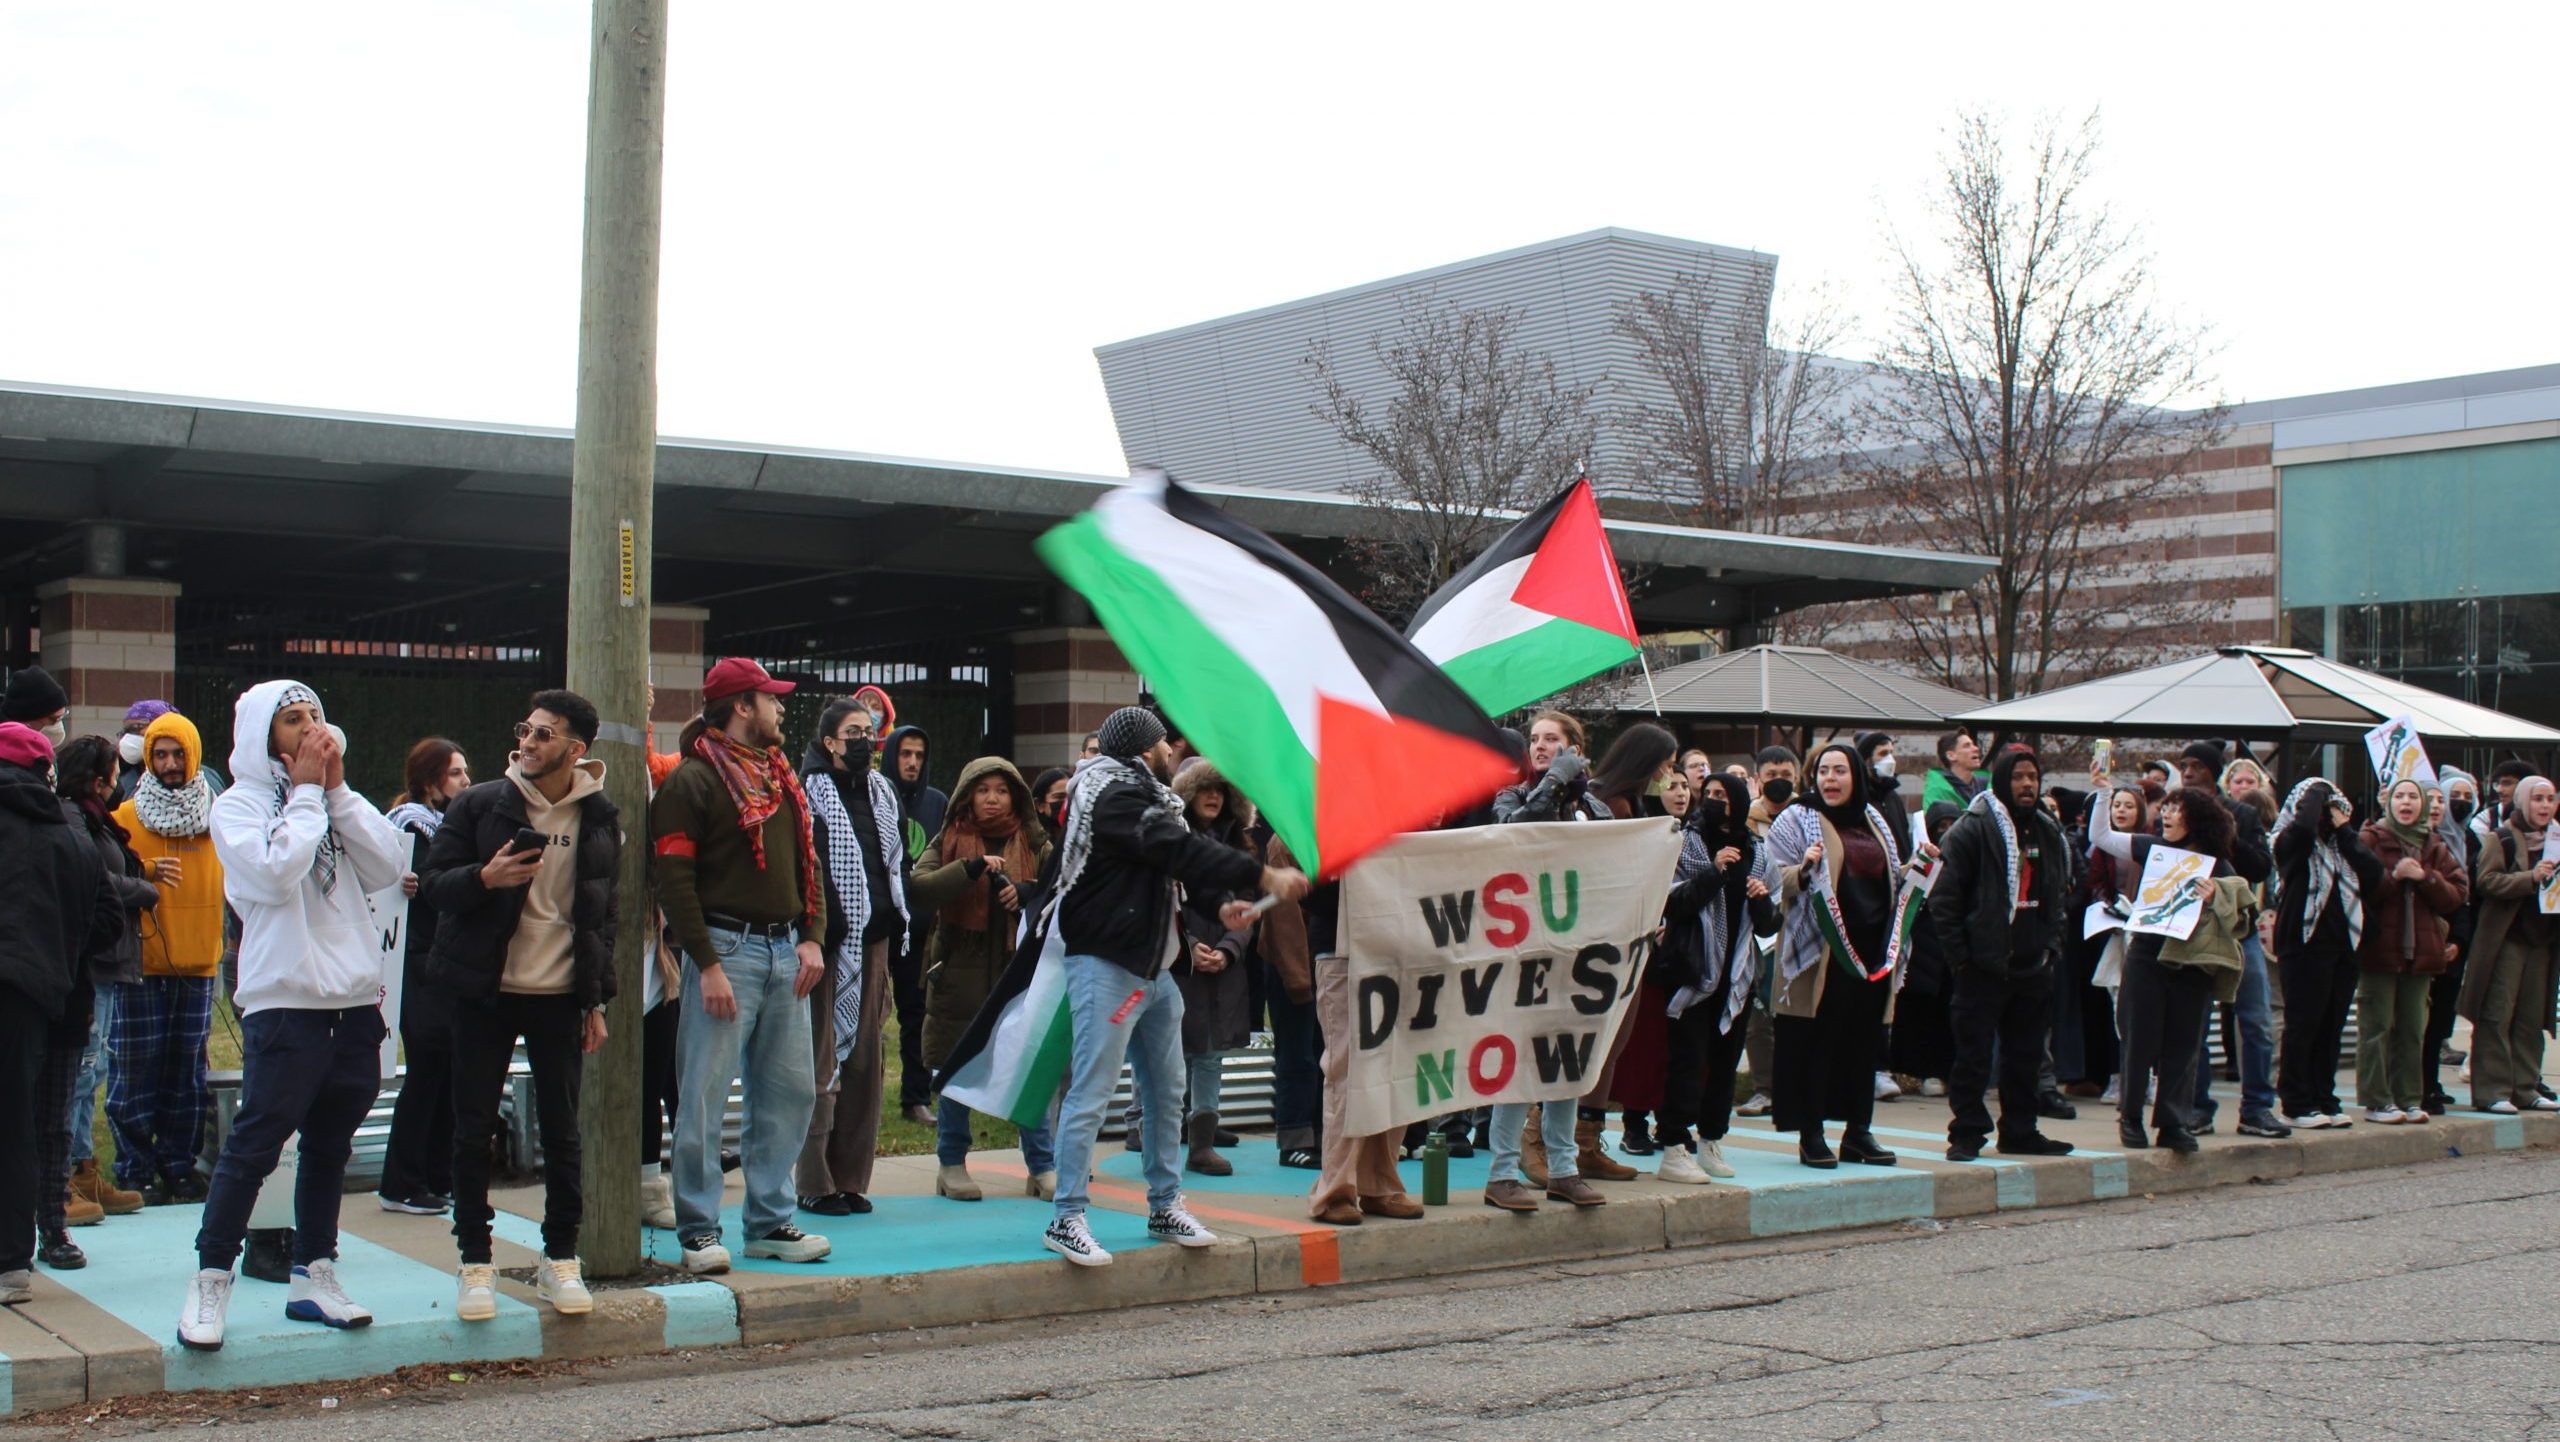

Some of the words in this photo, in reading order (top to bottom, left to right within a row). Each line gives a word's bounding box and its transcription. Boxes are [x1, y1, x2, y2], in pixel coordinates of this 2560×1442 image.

[1418, 869, 1580, 949] WSU
[1358, 931, 1656, 1051] DIVEST
[1415, 1033, 1597, 1107] NOW
